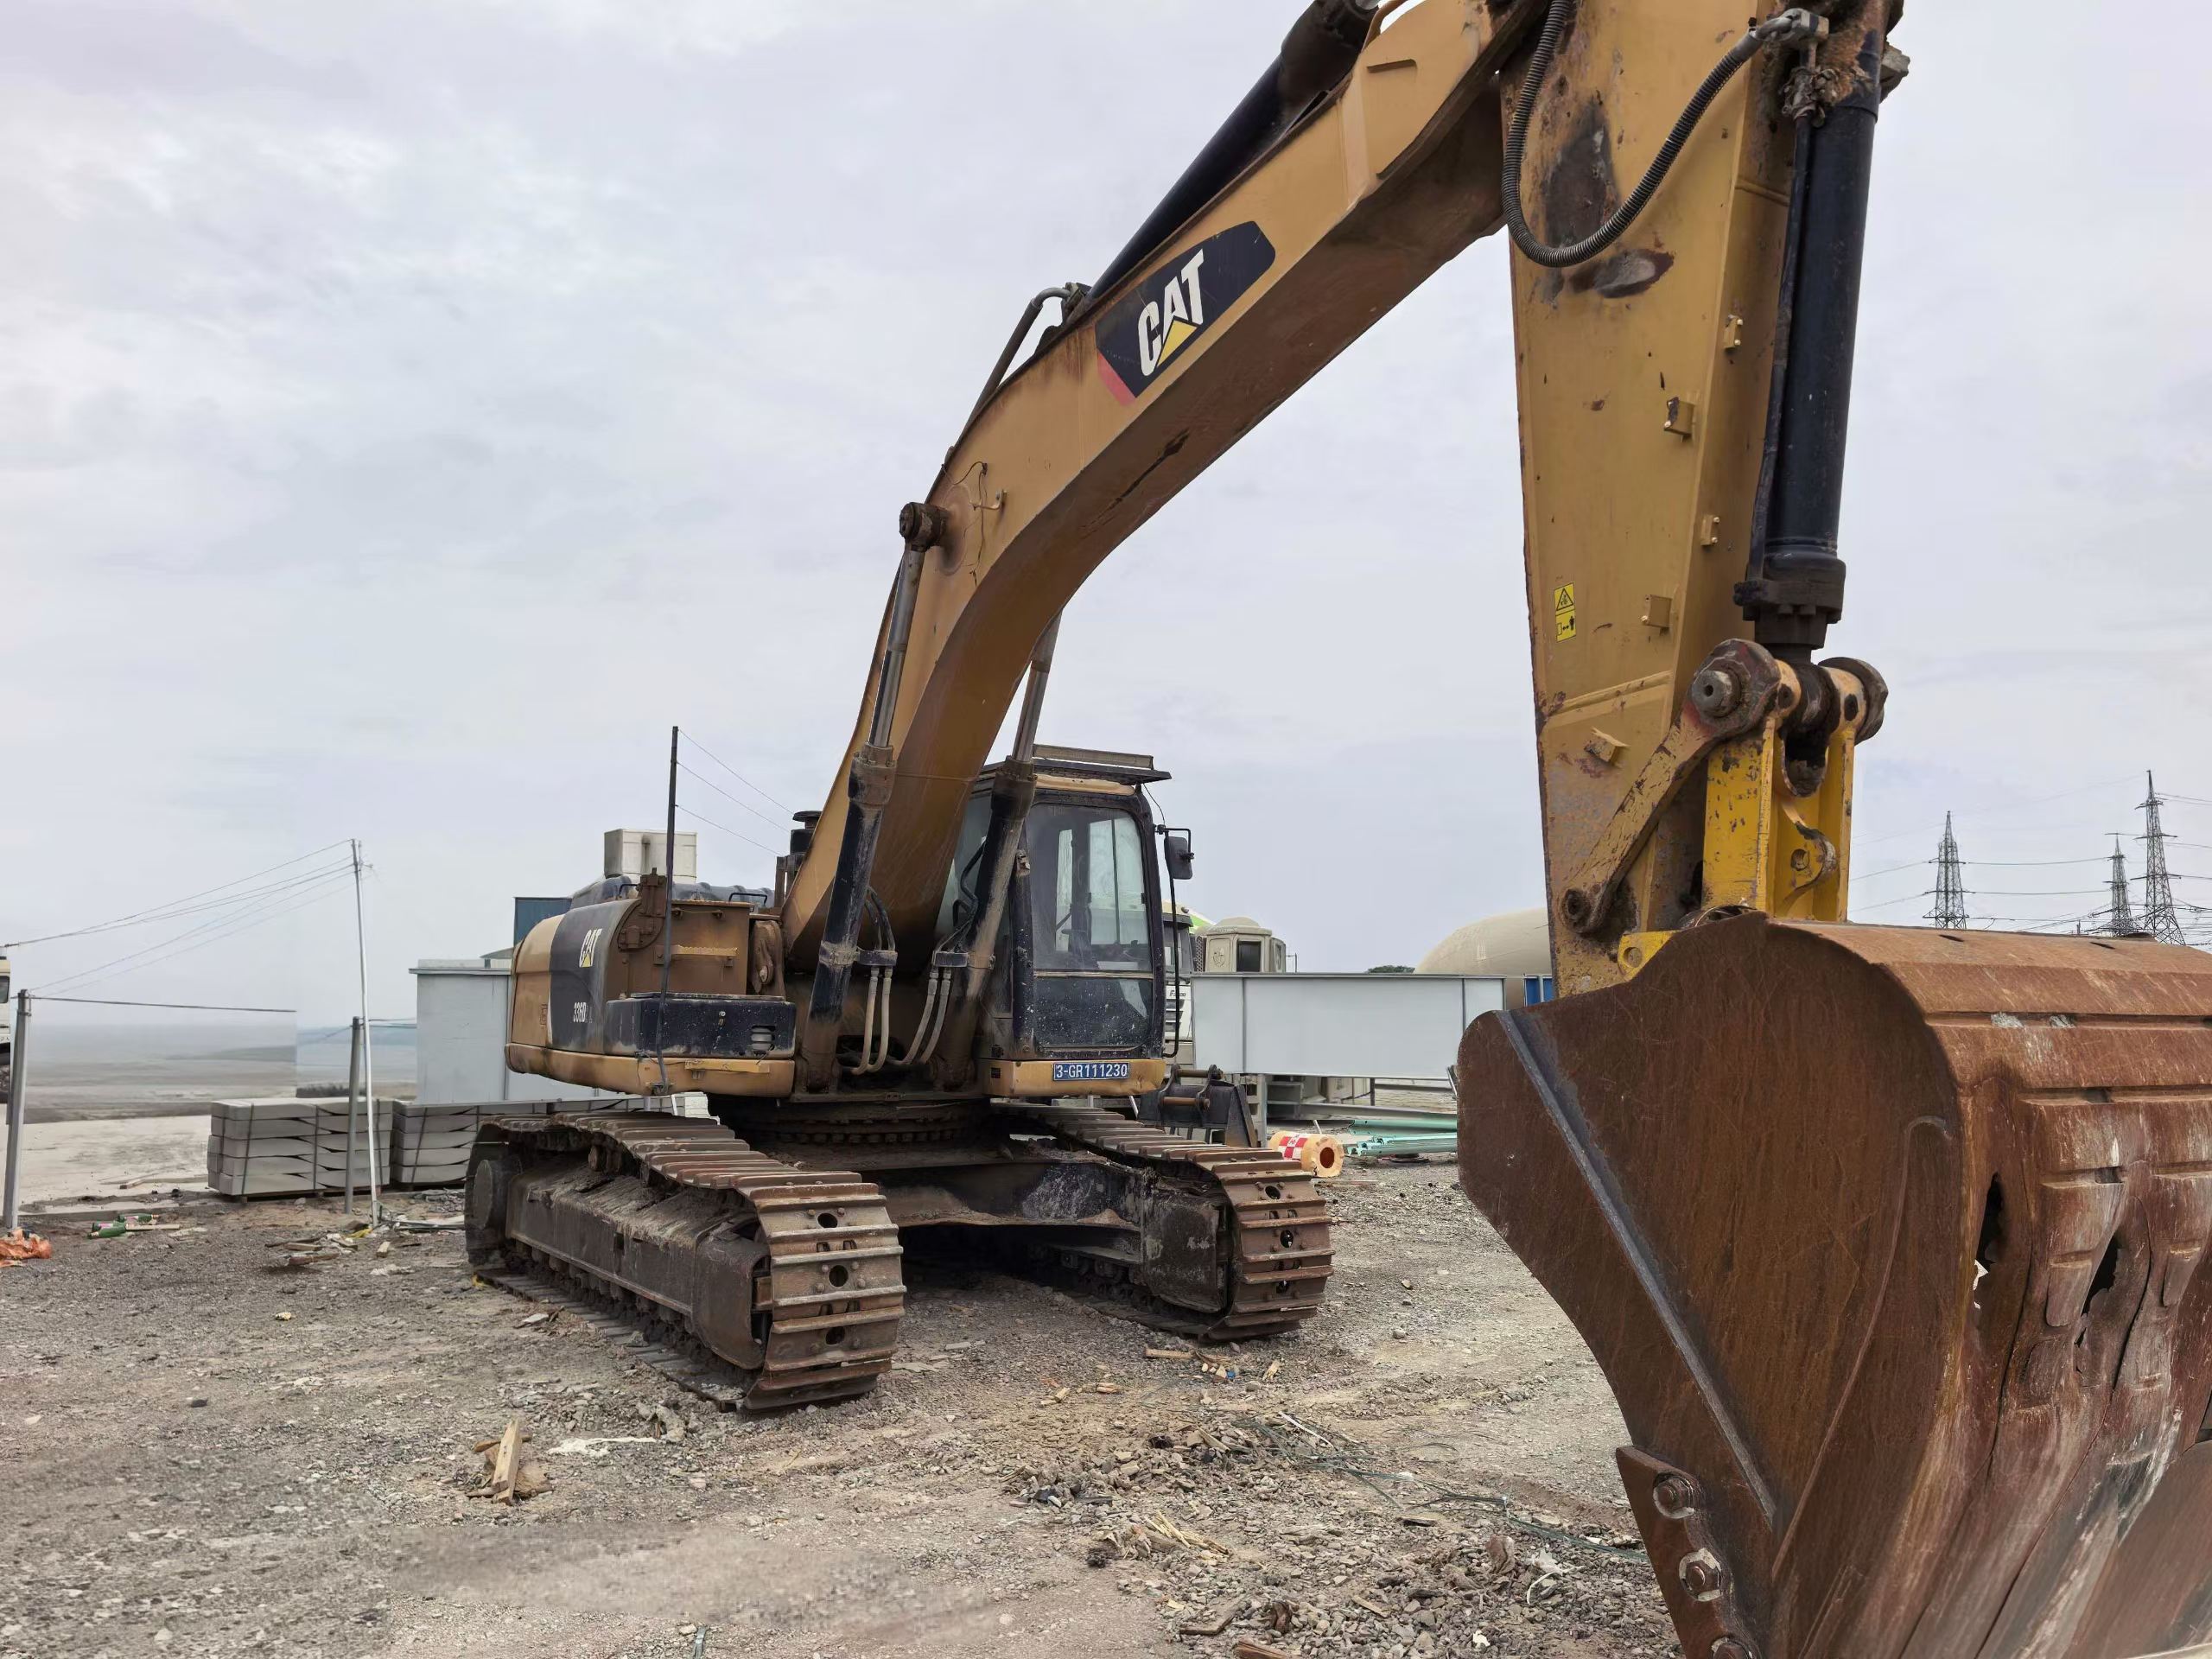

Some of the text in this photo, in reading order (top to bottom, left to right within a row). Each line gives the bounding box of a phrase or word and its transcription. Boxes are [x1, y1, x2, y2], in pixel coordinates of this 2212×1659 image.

[1138, 248, 1205, 377] CAT
[579, 928, 603, 968] CAT
[1056, 1063, 1128, 1078] 3-GR111230
